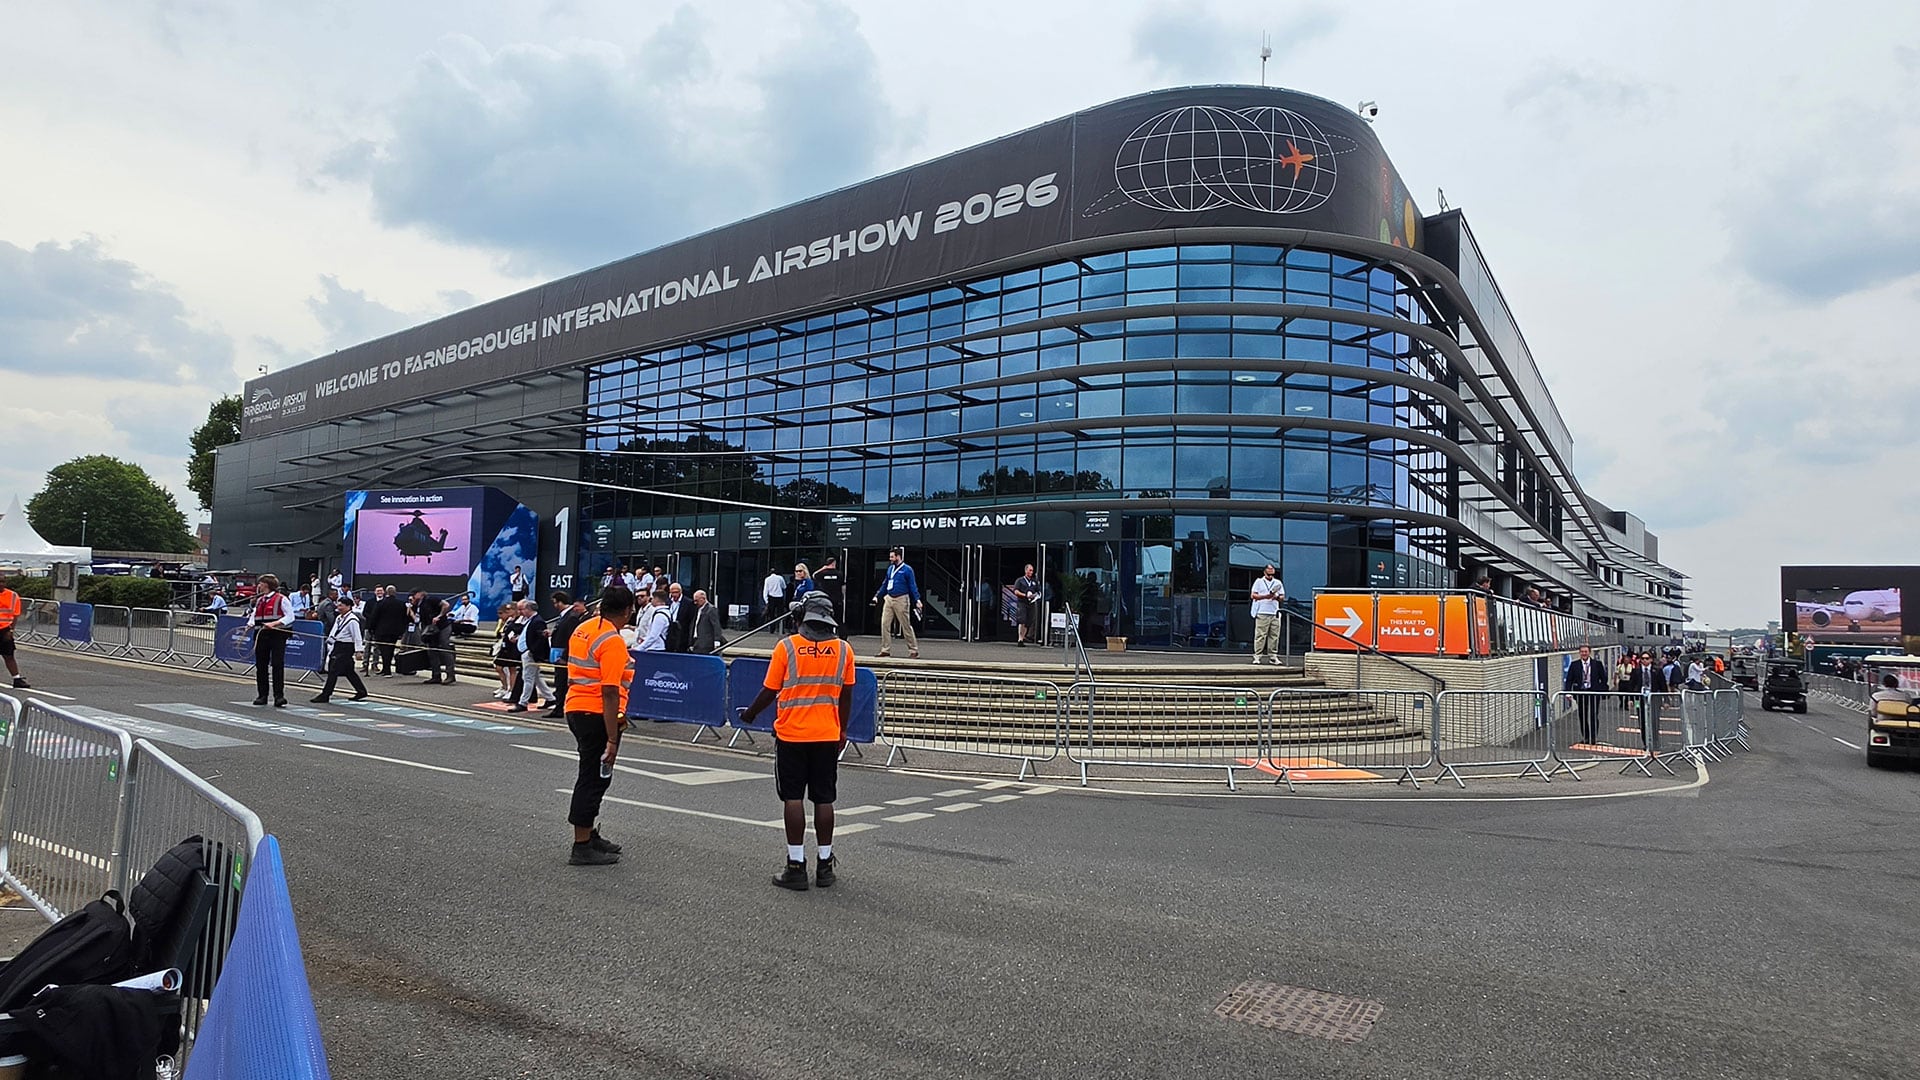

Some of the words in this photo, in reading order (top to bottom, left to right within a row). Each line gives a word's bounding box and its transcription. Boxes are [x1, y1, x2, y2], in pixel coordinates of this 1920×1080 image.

[315, 366, 379, 399] WELCOME
[381, 360, 401, 380] TO
[404, 321, 537, 375] FARNBOROUGH
[542, 265, 740, 338] INTERNATIONAL
[747, 211, 923, 284] AIRSHOW
[933, 172, 1059, 235] 2026
[380, 495, 391, 503] See
[391, 494, 419, 503] innovation
[426, 494, 443, 502] action
[555, 507, 569, 566] 1
[550, 575, 573, 588] EAST
[1380, 626, 1420, 636] HALL
